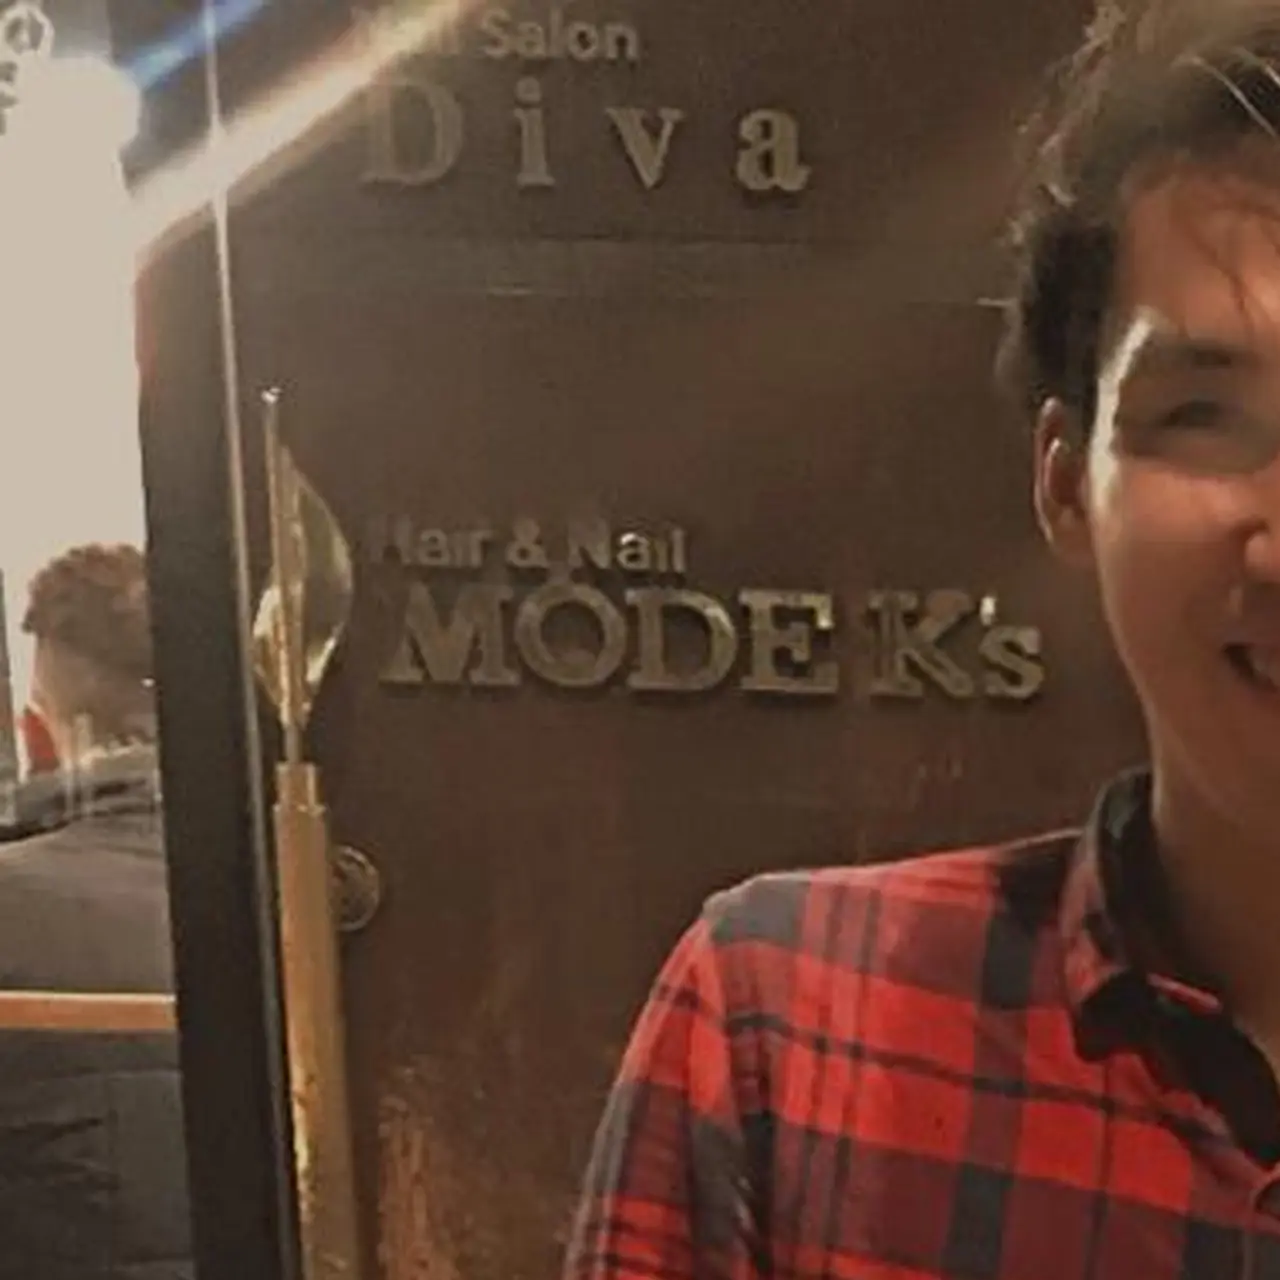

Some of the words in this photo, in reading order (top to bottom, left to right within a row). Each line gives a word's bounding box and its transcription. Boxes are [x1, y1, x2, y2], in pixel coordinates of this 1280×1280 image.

[480, 6, 639, 61] Salon
[358, 75, 811, 192] Diva
[508, 516, 553, 569] &
[567, 516, 687, 573] Nail
[379, 582, 839, 694] MODE
[867, 589, 1046, 699] K's
